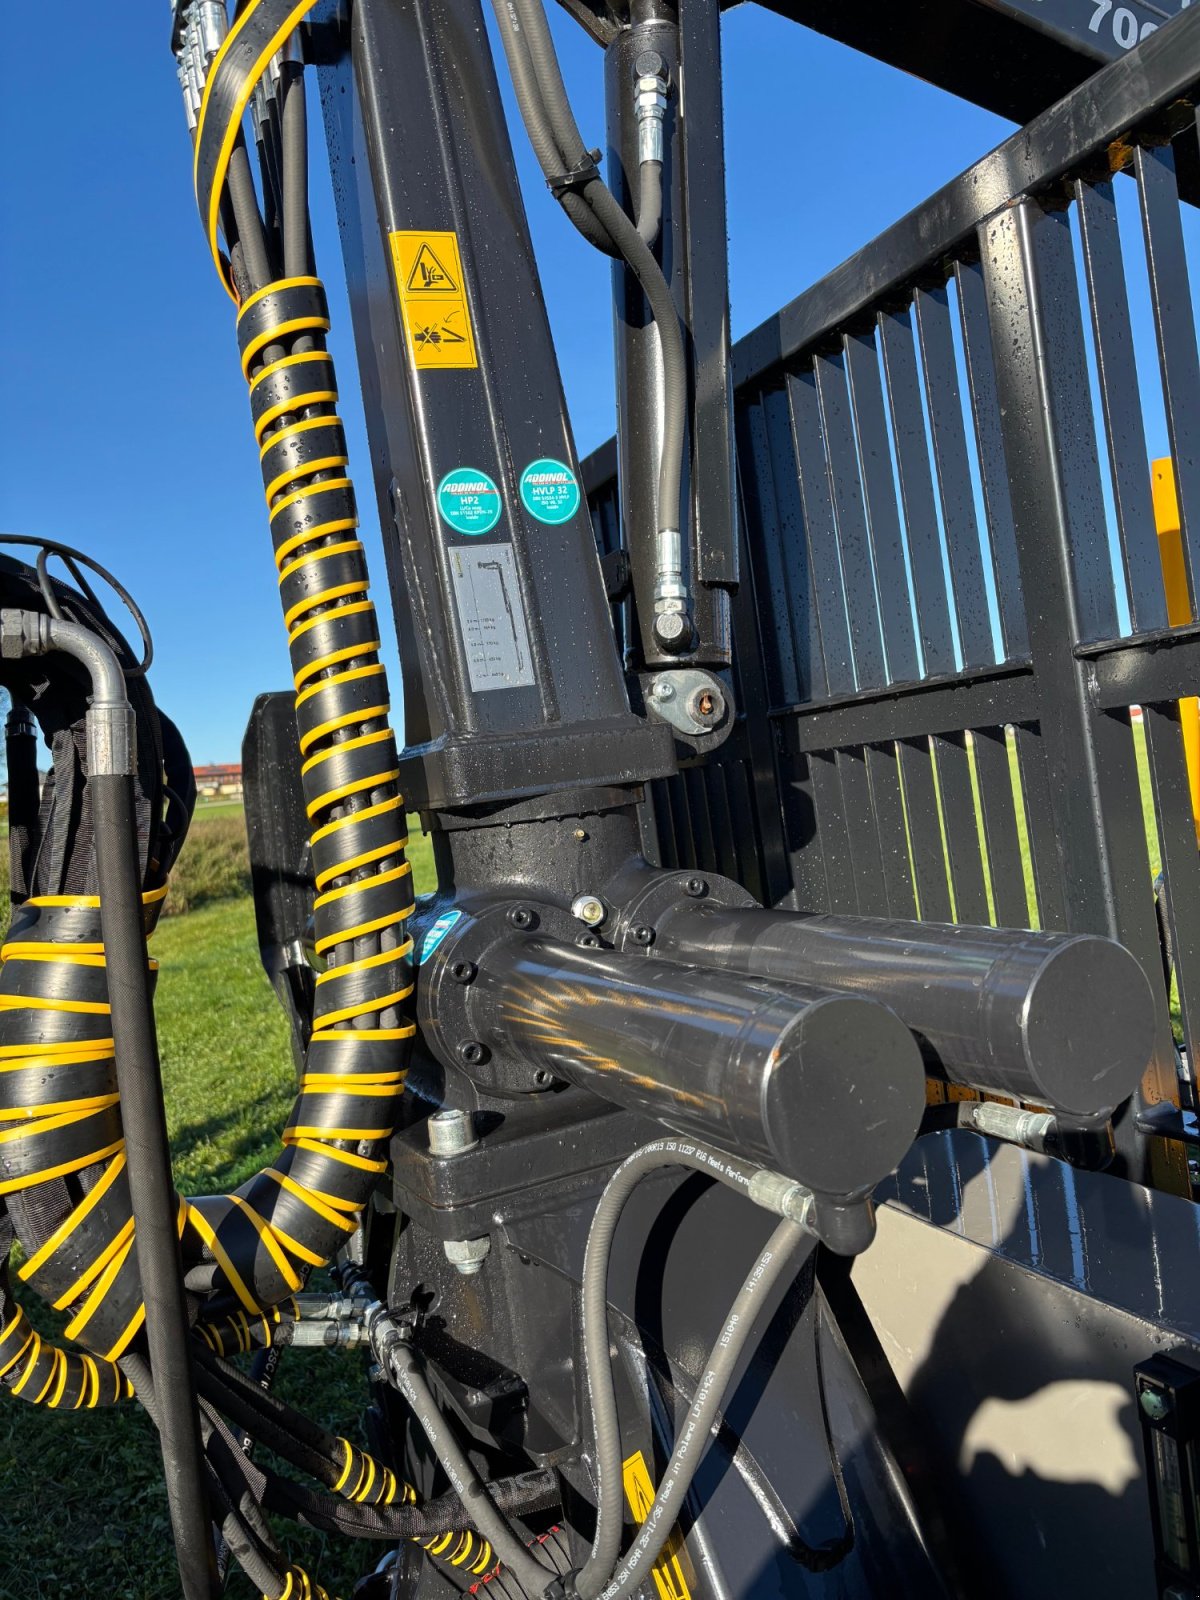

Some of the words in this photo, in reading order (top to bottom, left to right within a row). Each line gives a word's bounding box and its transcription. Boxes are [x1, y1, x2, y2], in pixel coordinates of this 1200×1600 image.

[442, 482, 489, 493] ADDINOL
[524, 472, 568, 483] ADDINOL
[460, 496, 479, 505] HP2
[532, 486, 555, 495] HVLP
[557, 485, 568, 494] 32
[665, 1142, 677, 1150] ISO
[678, 1144, 696, 1155] 11237
[696, 1149, 708, 1162] R16
[707, 1155, 725, 1172] Meets
[725, 1165, 751, 1186] Perform
[745, 1252, 773, 1294] 14:39:53
[719, 1314, 740, 1349] 151040
[264, 1347, 280, 1373] 2SC
[692, 1370, 717, 1418] LP101424
[676, 1421, 696, 1461] Poland
[672, 1461, 682, 1476] in
[659, 1478, 675, 1504] Made
[626, 1548, 644, 1571] MSHA
[617, 1569, 631, 1586] 2SN
